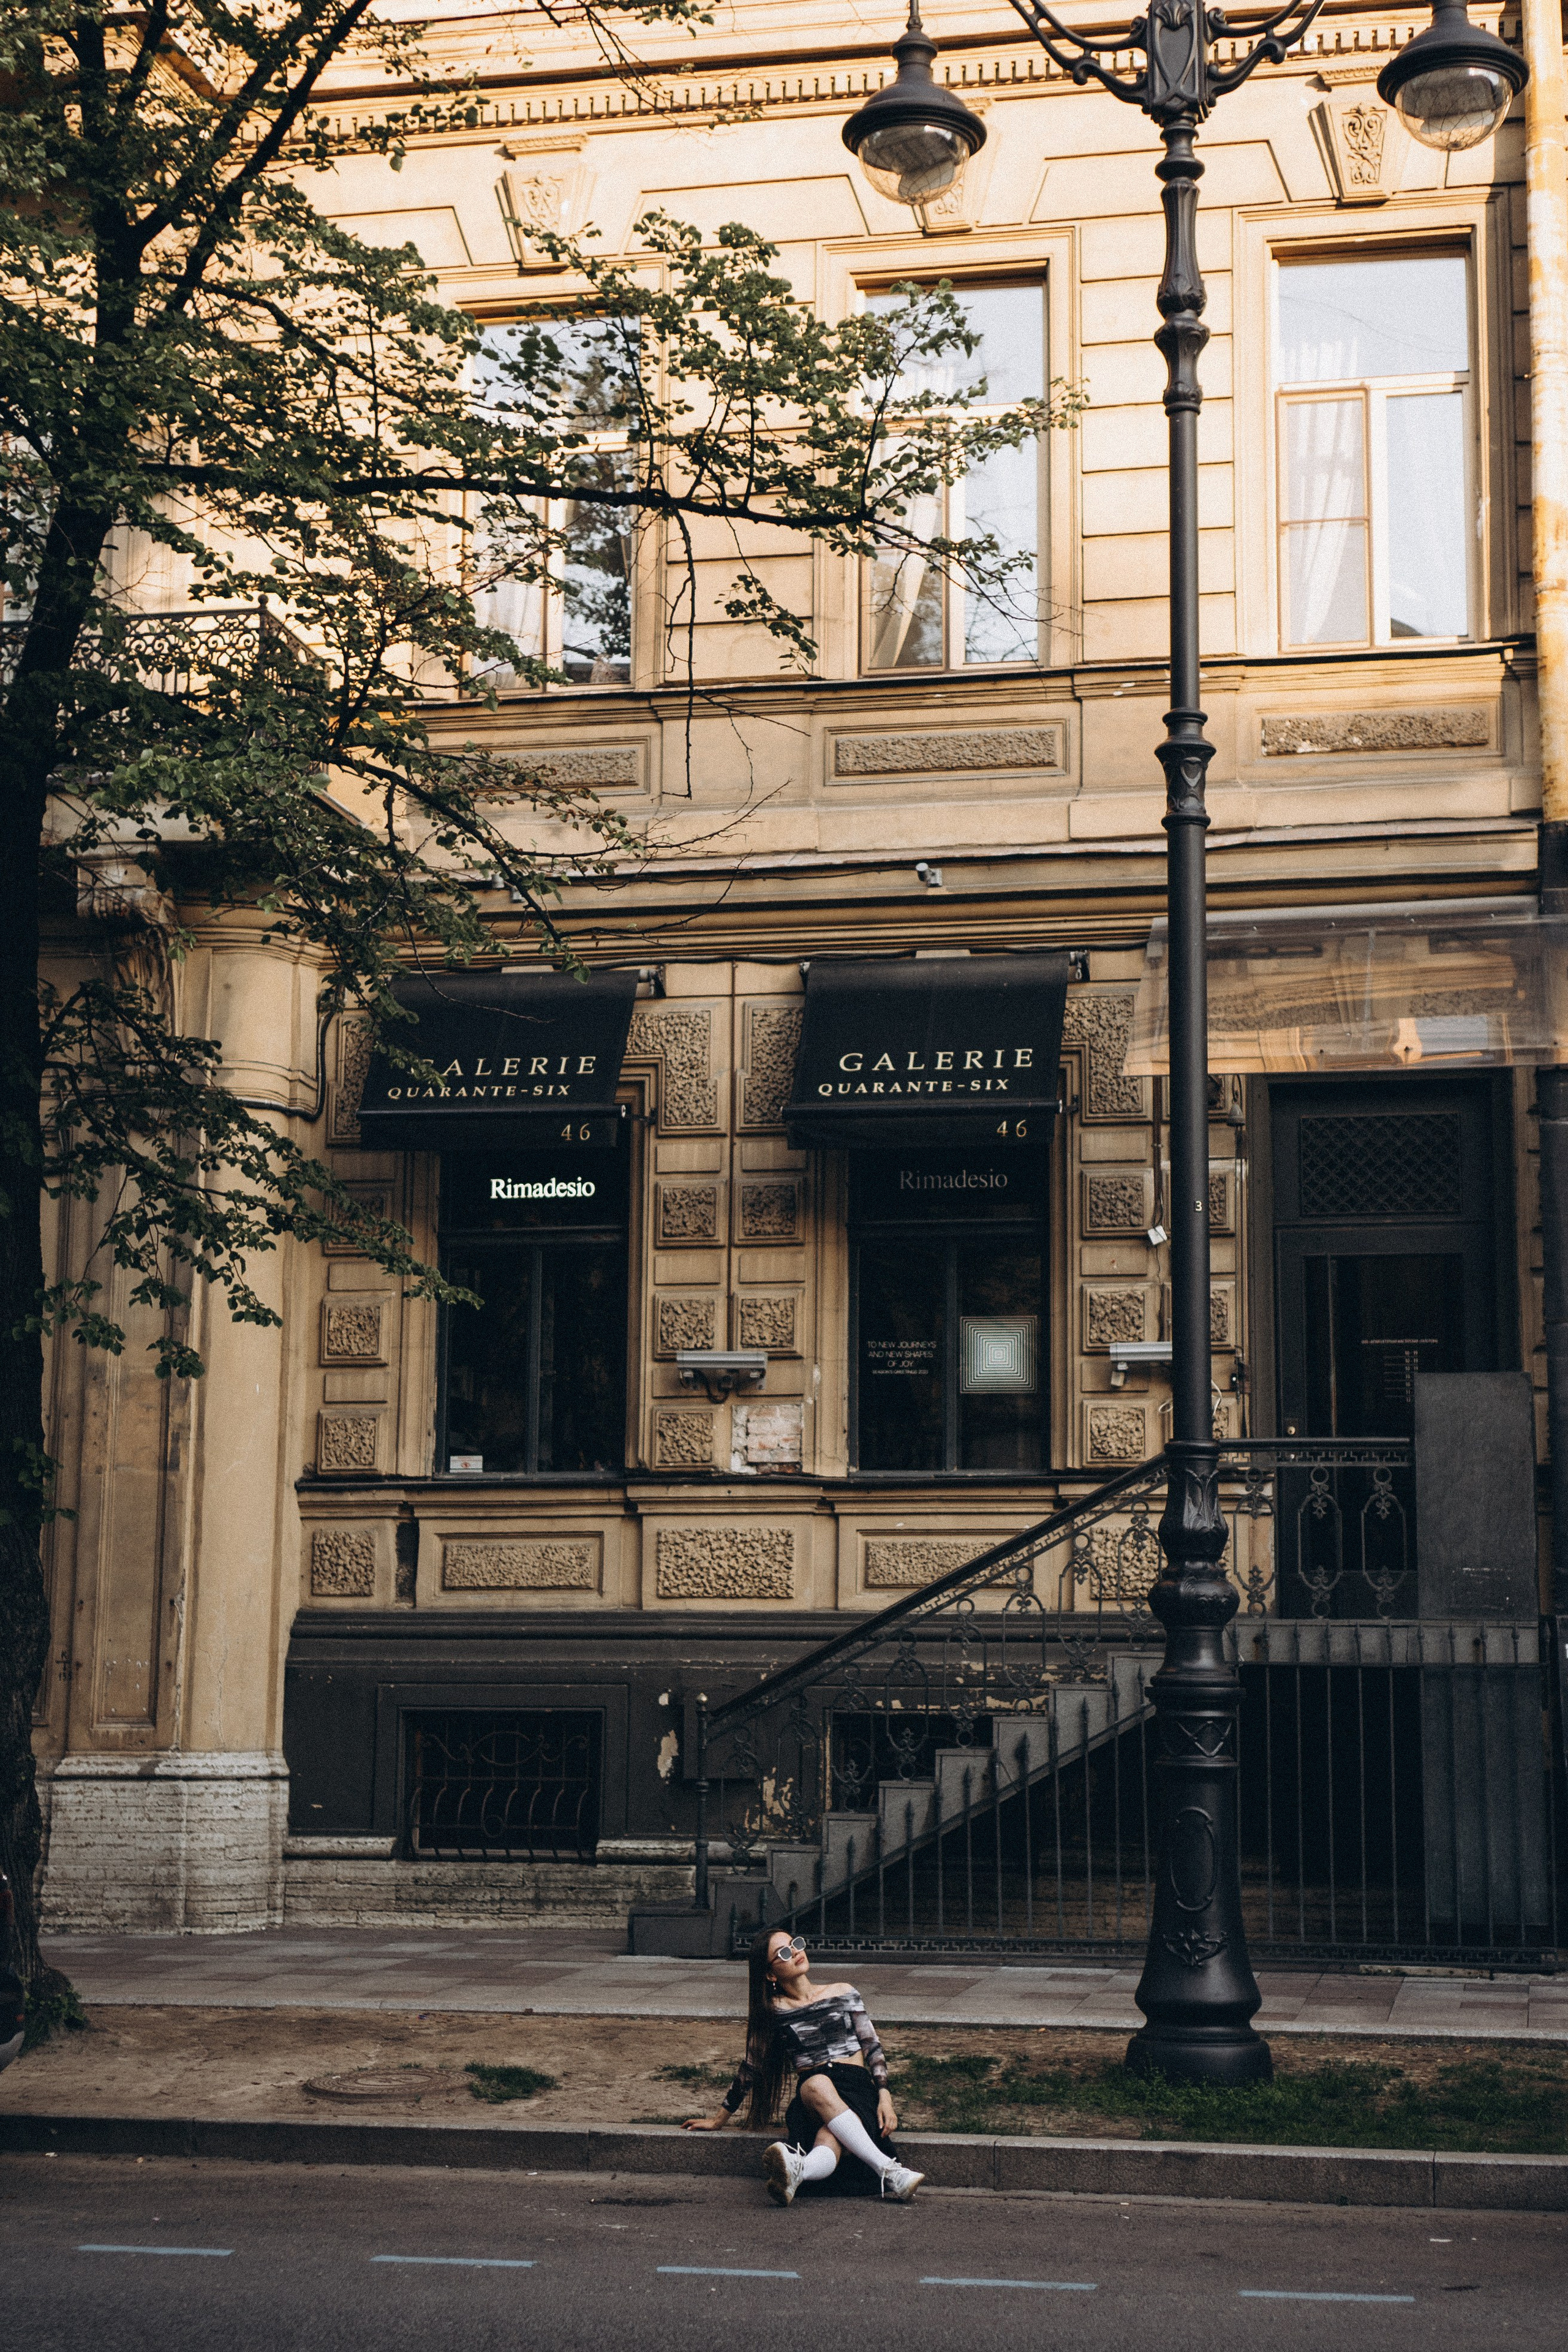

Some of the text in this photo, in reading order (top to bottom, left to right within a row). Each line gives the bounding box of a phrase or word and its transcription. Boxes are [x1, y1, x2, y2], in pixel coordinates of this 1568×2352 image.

[839, 1048, 1033, 1071] GALERIE
[388, 1084, 570, 1099] QUARANTE-SIX
[818, 1079, 1009, 1096] QUARANTE-SIX
[490, 1176, 595, 1199] Rimadesio
[900, 1168, 1008, 1189] Rimadesio
[1195, 1200, 1202, 1212] 3
